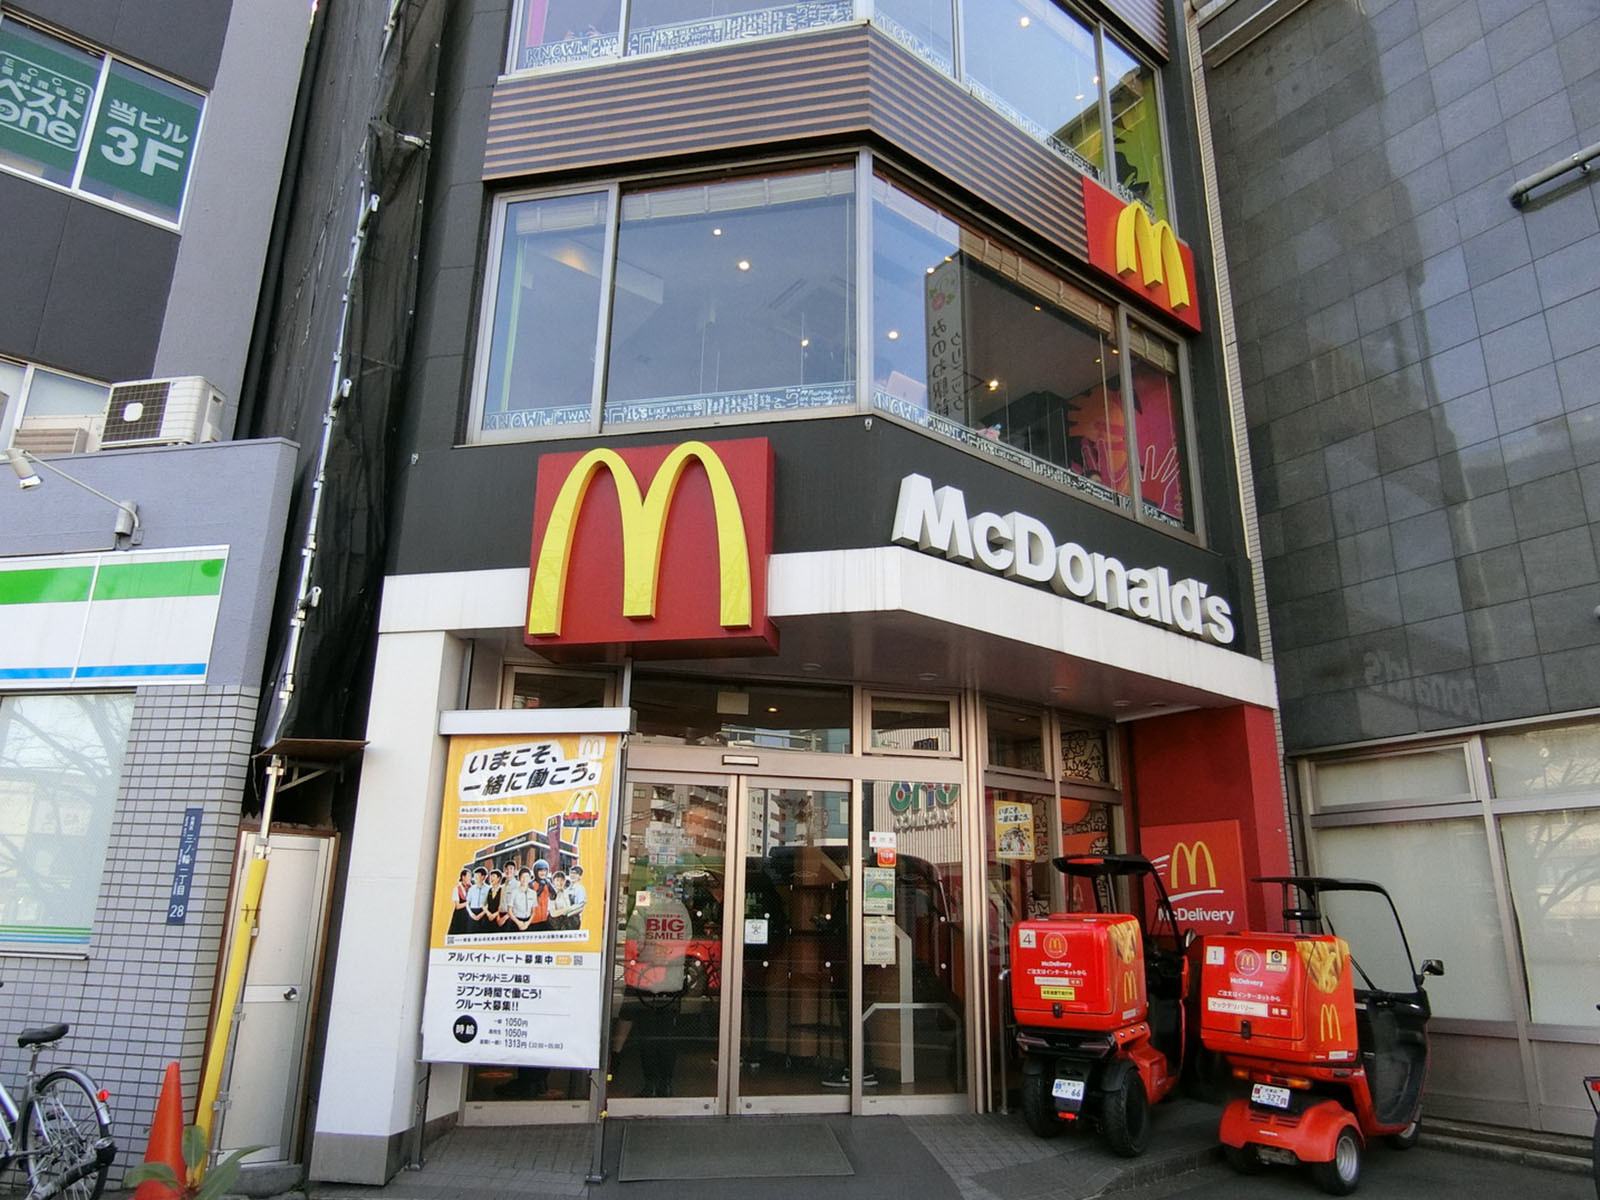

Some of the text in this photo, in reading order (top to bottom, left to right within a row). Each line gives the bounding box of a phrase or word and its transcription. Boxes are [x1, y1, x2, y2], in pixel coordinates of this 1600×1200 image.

[0, 78, 82, 120] ベスト
[108, 98, 189, 144] 当ビル
[100, 125, 184, 177] 3F
[891, 472, 1235, 644] McDonald's
[468, 744, 558, 774] いまこそ、
[463, 762, 596, 796] 一緒に働こう。
[169, 904, 185, 918] 28
[1158, 907, 1235, 925] McDelivery
[646, 918, 685, 932] BIG
[645, 932, 685, 941] SMILE
[1023, 933, 1032, 945] 4
[457, 972, 531, 984] マクドナルド三ノ輪店
[455, 1024, 475, 1035] 時給
[504, 1017, 529, 1028] 1050円
[504, 1028, 528, 1039] 1050円
[504, 1039, 528, 1049] 1313円
